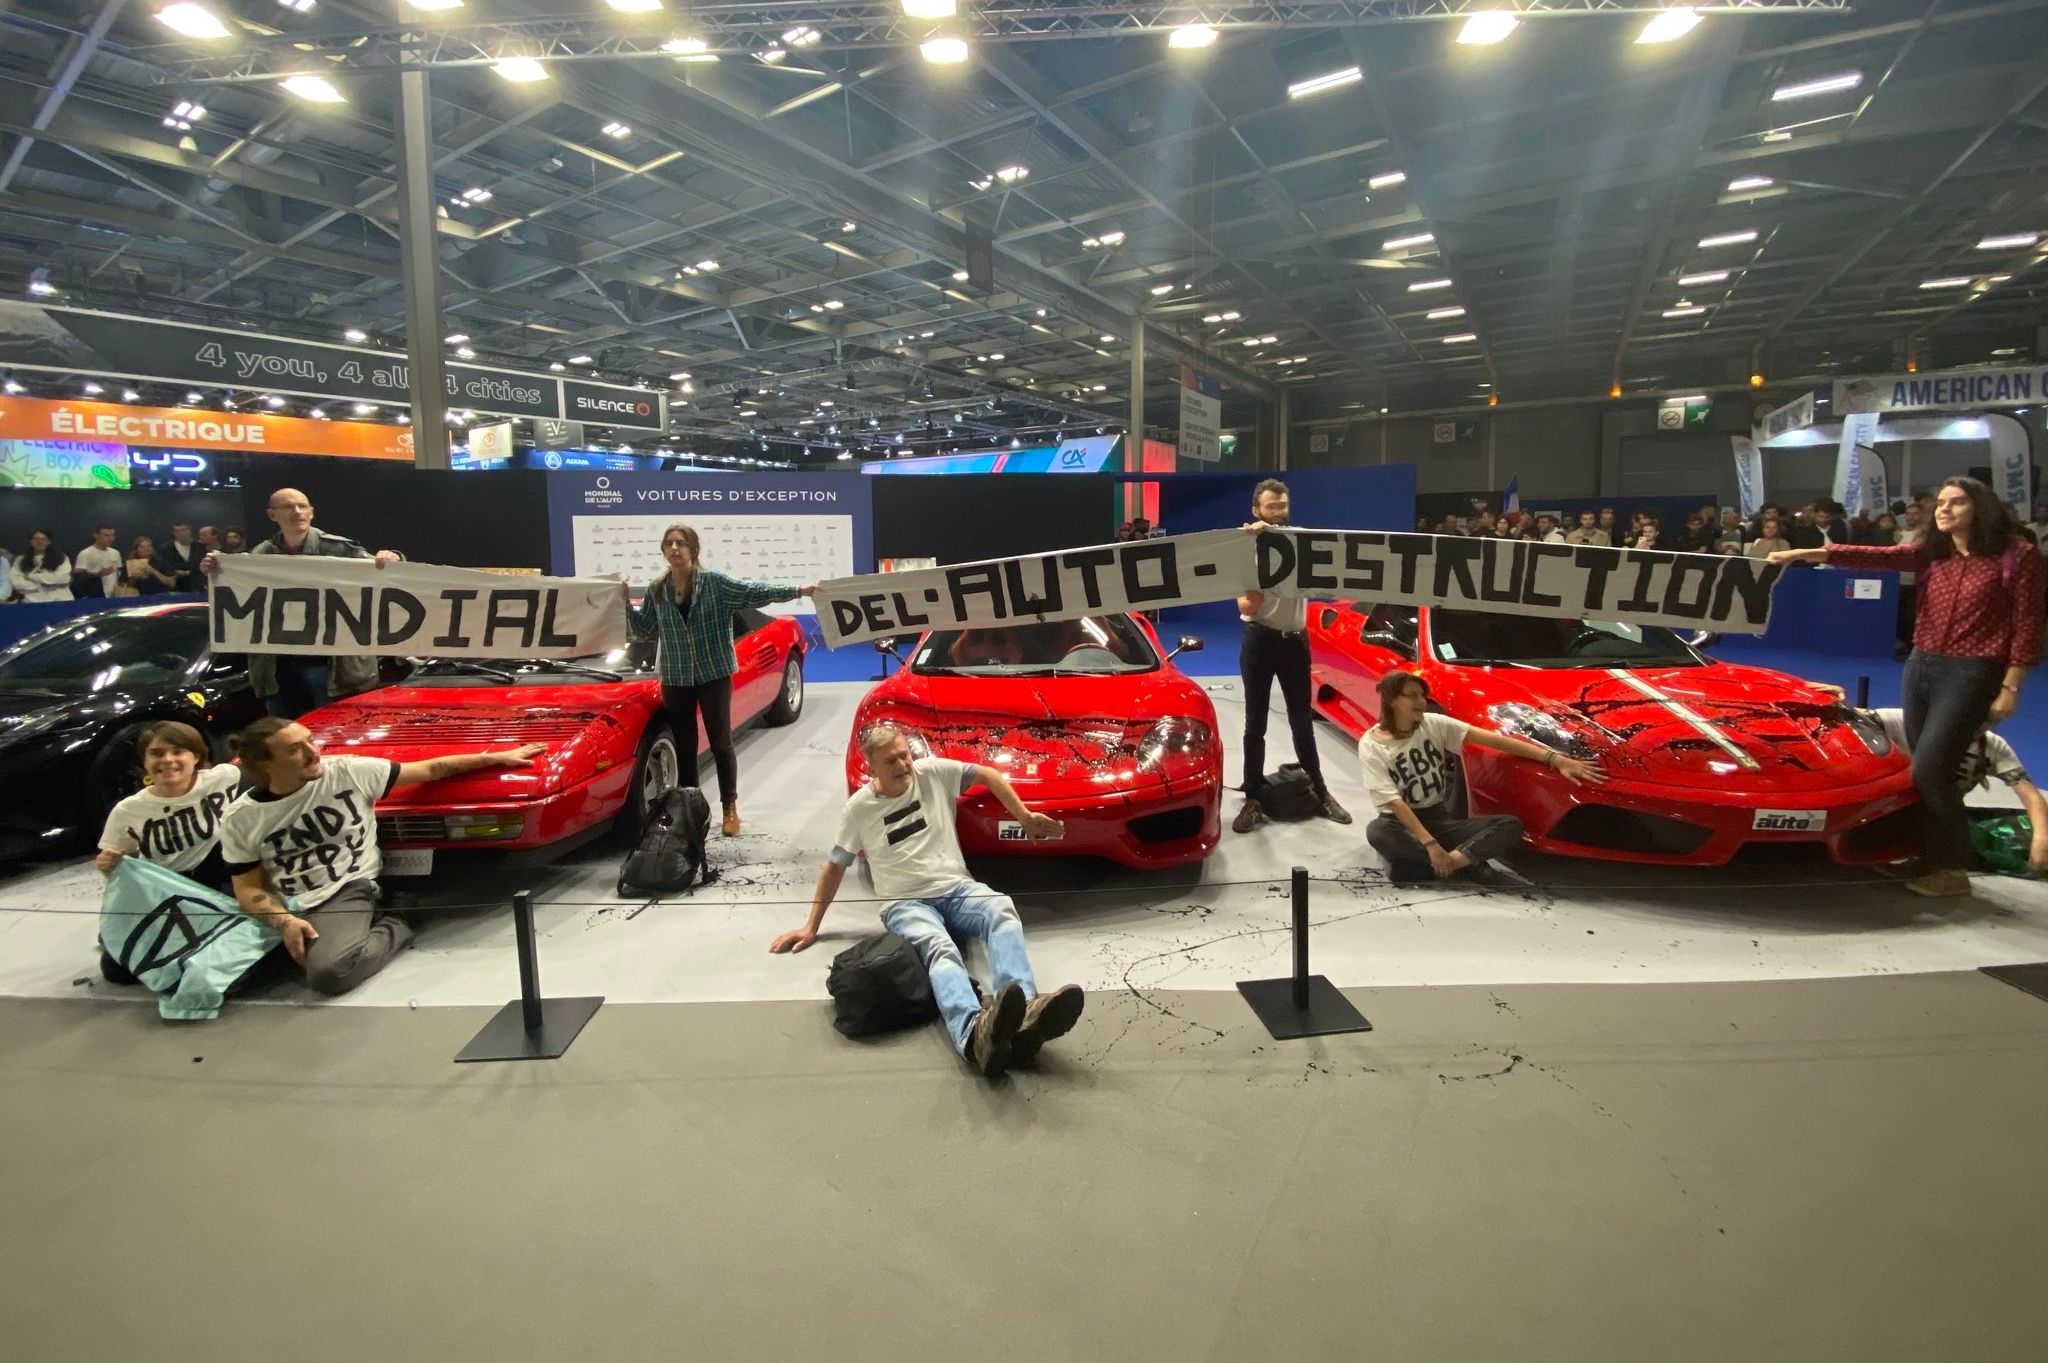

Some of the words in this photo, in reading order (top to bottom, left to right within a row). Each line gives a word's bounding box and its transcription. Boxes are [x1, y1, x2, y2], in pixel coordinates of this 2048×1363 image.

[195, 342, 226, 368] 4
[234, 351, 328, 384] you,
[338, 361, 363, 384] 4
[466, 378, 542, 404] cities
[1891, 373, 2031, 407] AMERICAN
[577, 396, 635, 414] SILENCE
[51, 407, 265, 444] ÉLECTRIQUE
[45, 452, 83, 471] BOX
[126, 452, 207, 472] YD
[637, 490, 723, 501] VOITURES
[729, 490, 837, 502] D'EXCEPTION
[1256, 532, 1786, 624] DESTRUCTION
[213, 586, 577, 648] MONDIAL
[264, 790, 363, 856] INDI
[1756, 816, 1809, 829] auto
